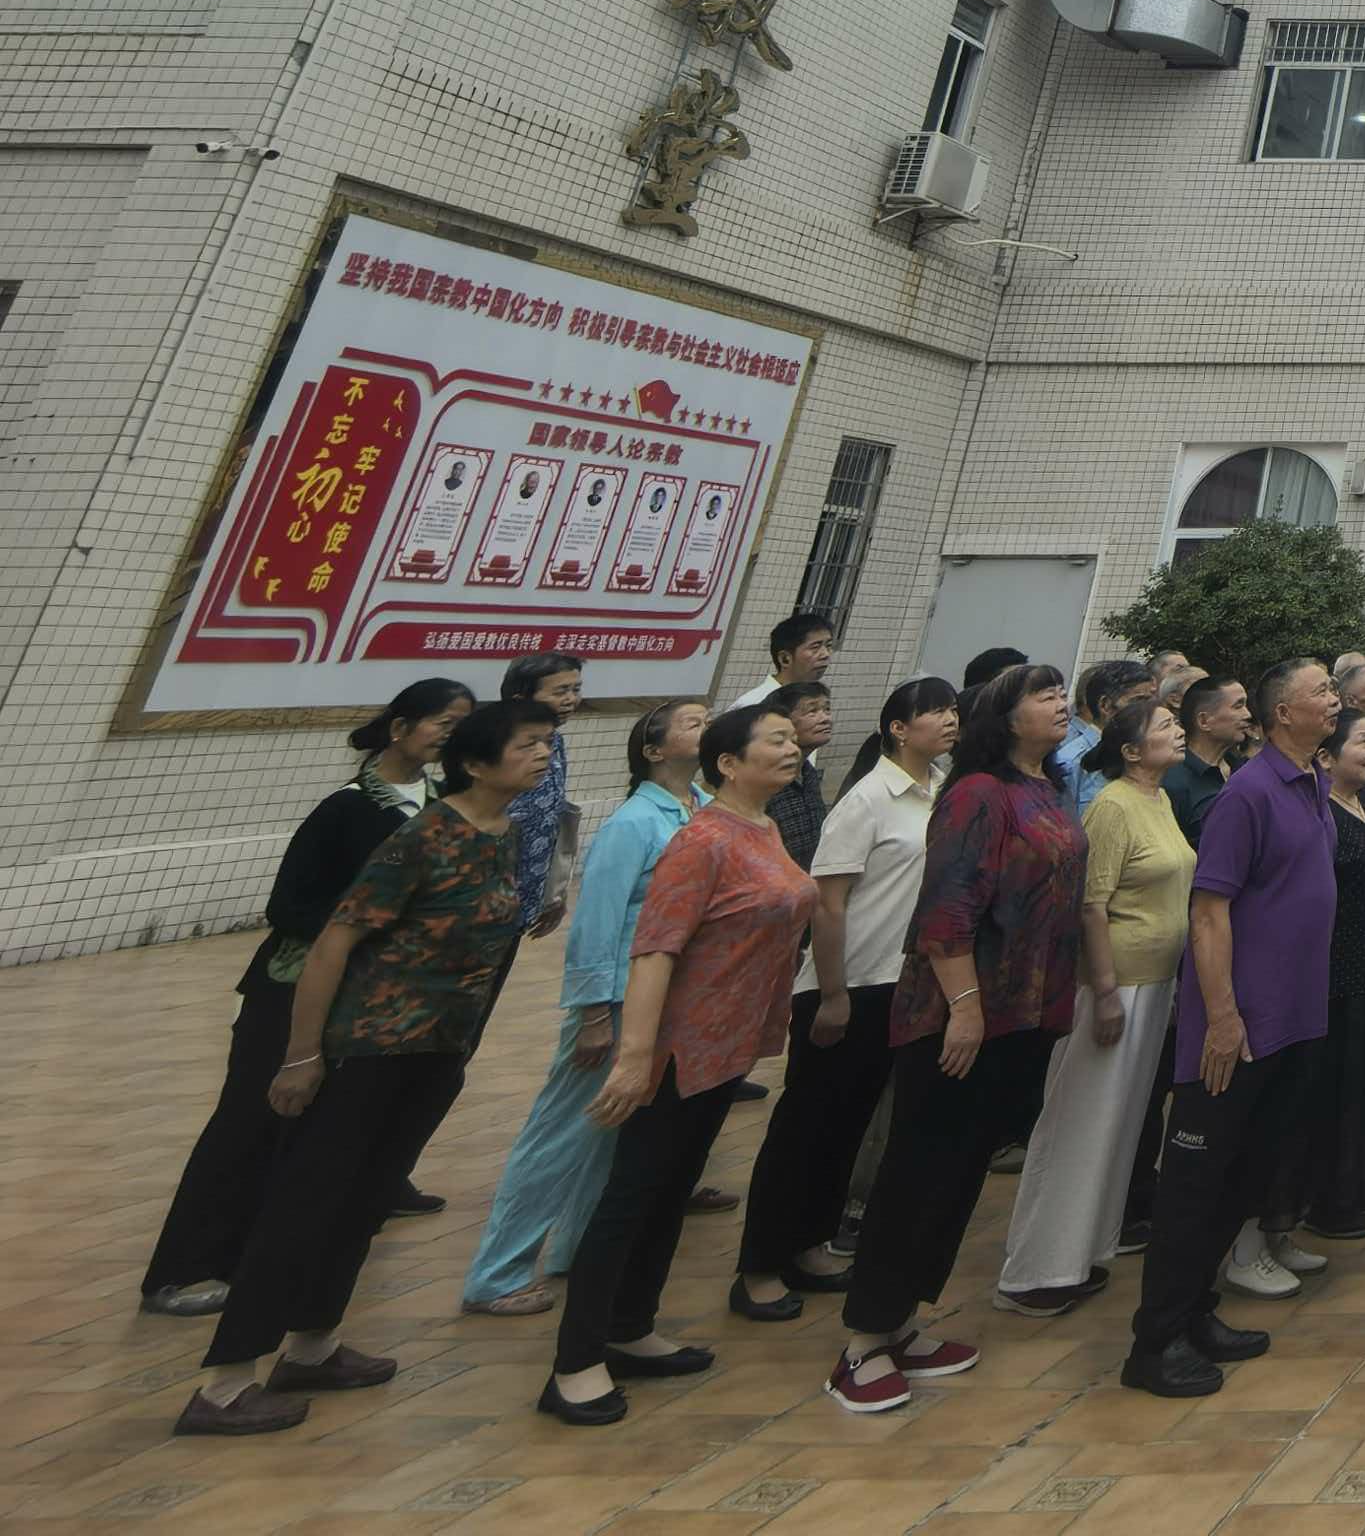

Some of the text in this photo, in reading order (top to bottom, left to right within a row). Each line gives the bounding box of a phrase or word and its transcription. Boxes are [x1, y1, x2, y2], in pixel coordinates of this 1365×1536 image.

[337, 251, 802, 386] 坚持我国宗教中国化方向 积极引导宗教与社会主义社会相适应
[286, 376, 371, 544] 不忘初心
[527, 422, 684, 466] 国家领导人论宗教
[306, 445, 383, 594] 牢记使命
[423, 631, 676, 653] 弘扬爱国爱教优良传统 走深走实基督教中国化方向
